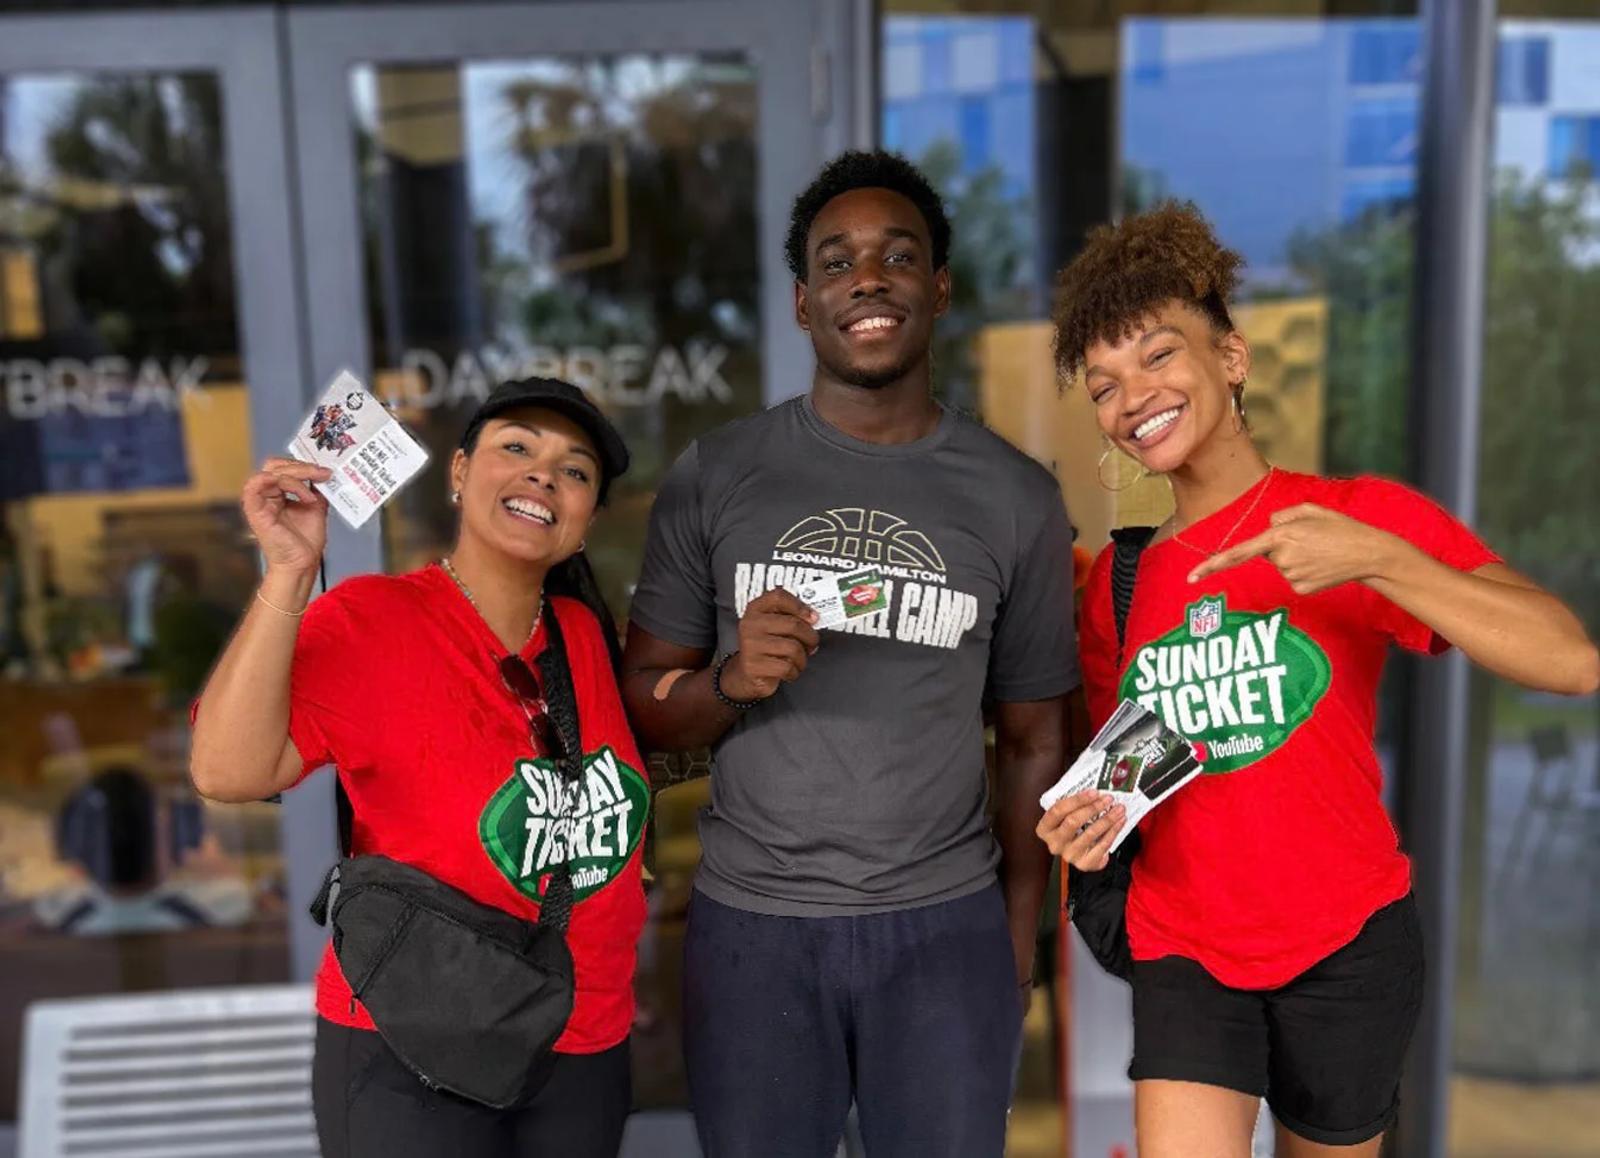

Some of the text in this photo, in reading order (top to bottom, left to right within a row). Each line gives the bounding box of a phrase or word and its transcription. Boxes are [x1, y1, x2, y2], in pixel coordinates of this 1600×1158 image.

[0, 356, 213, 420] BREAK
[773, 551, 857, 570] LEONARD
[858, 562, 947, 585] HAMILTON
[896, 582, 978, 649] CAMP
[1194, 615, 1217, 633] NFL
[1135, 613, 1282, 692] SUNDAY
[1136, 664, 1287, 735] TICKET
[1207, 733, 1264, 760] YouTube
[570, 864, 608, 890] ouTube
